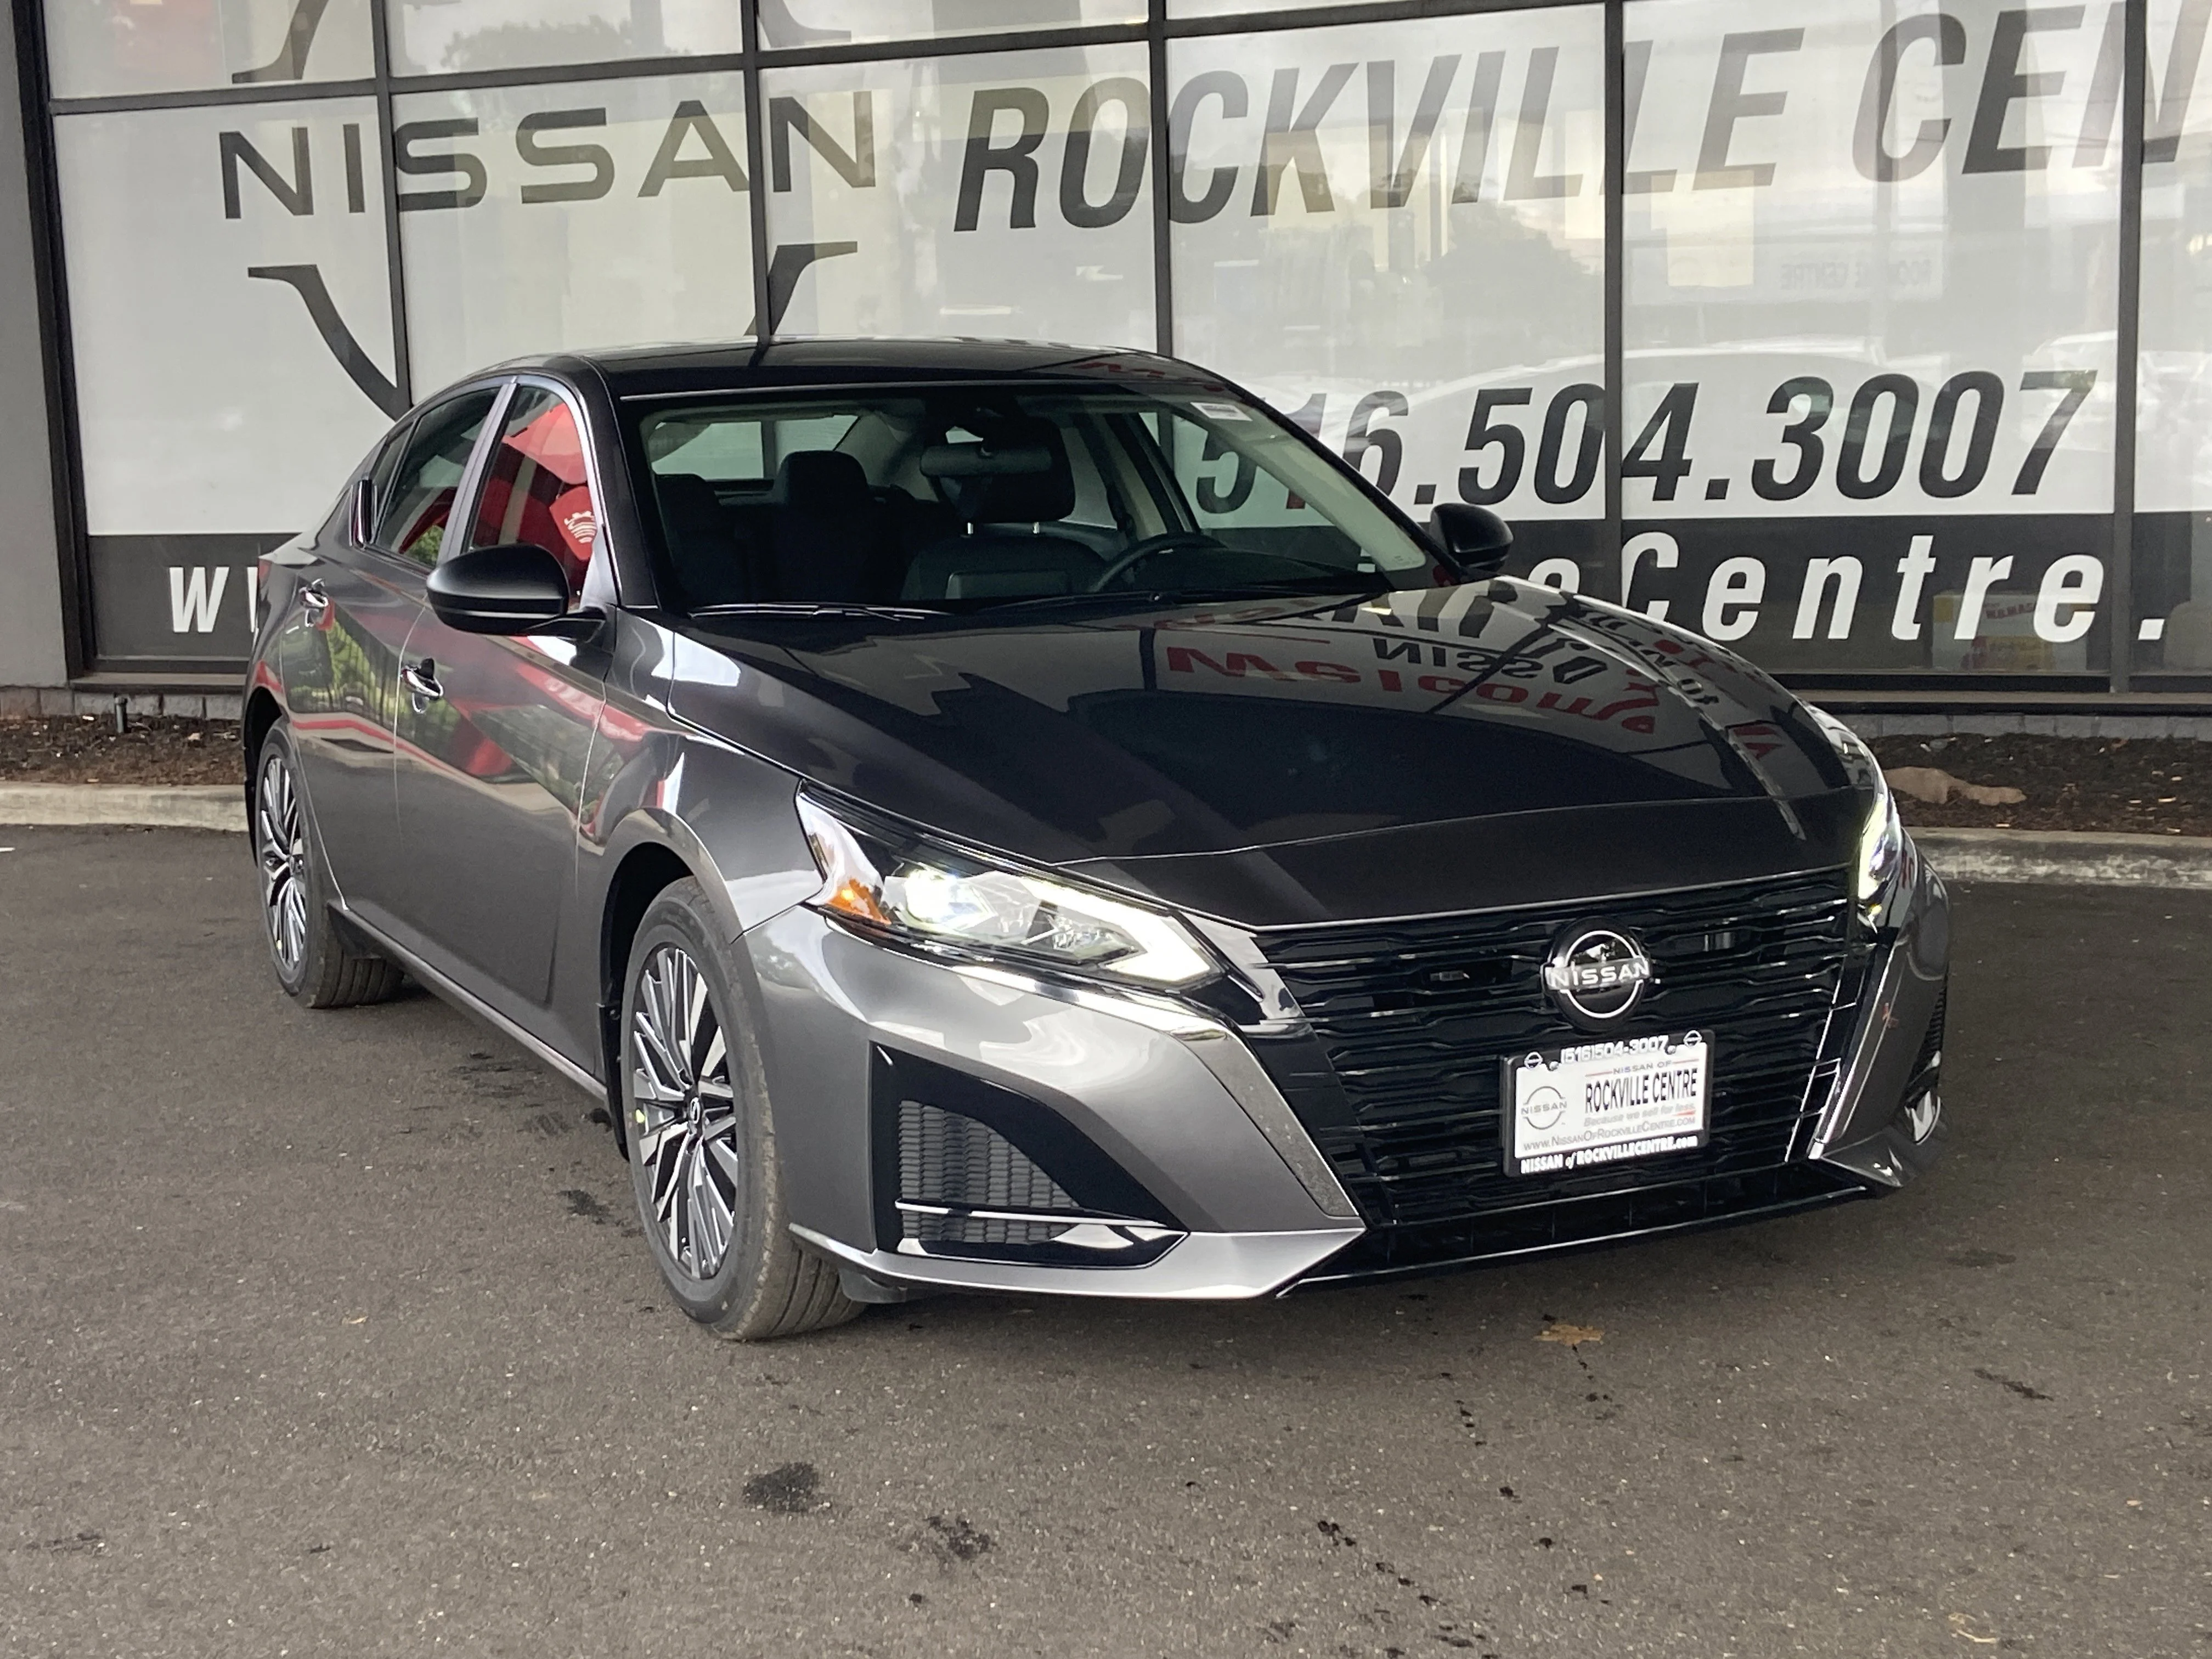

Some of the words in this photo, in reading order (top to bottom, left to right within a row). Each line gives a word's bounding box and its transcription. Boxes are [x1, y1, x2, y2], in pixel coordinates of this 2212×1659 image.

[954, 27, 1805, 232] ROCKVILLE
[220, 91, 876, 219] NISSAN
[1544, 958, 1650, 988] NISSAN
[1613, 1062, 1654, 1075] NISSAN
[1657, 1060, 1672, 1068] OF
[1585, 1074, 1649, 1114] ROCKVILLE
[1652, 1068, 1697, 1103] CENTRE
[1521, 1100, 1567, 1116] NISSAN
[1521, 1154, 1564, 1174] NISSAN
[1565, 1151, 1577, 1170] of
